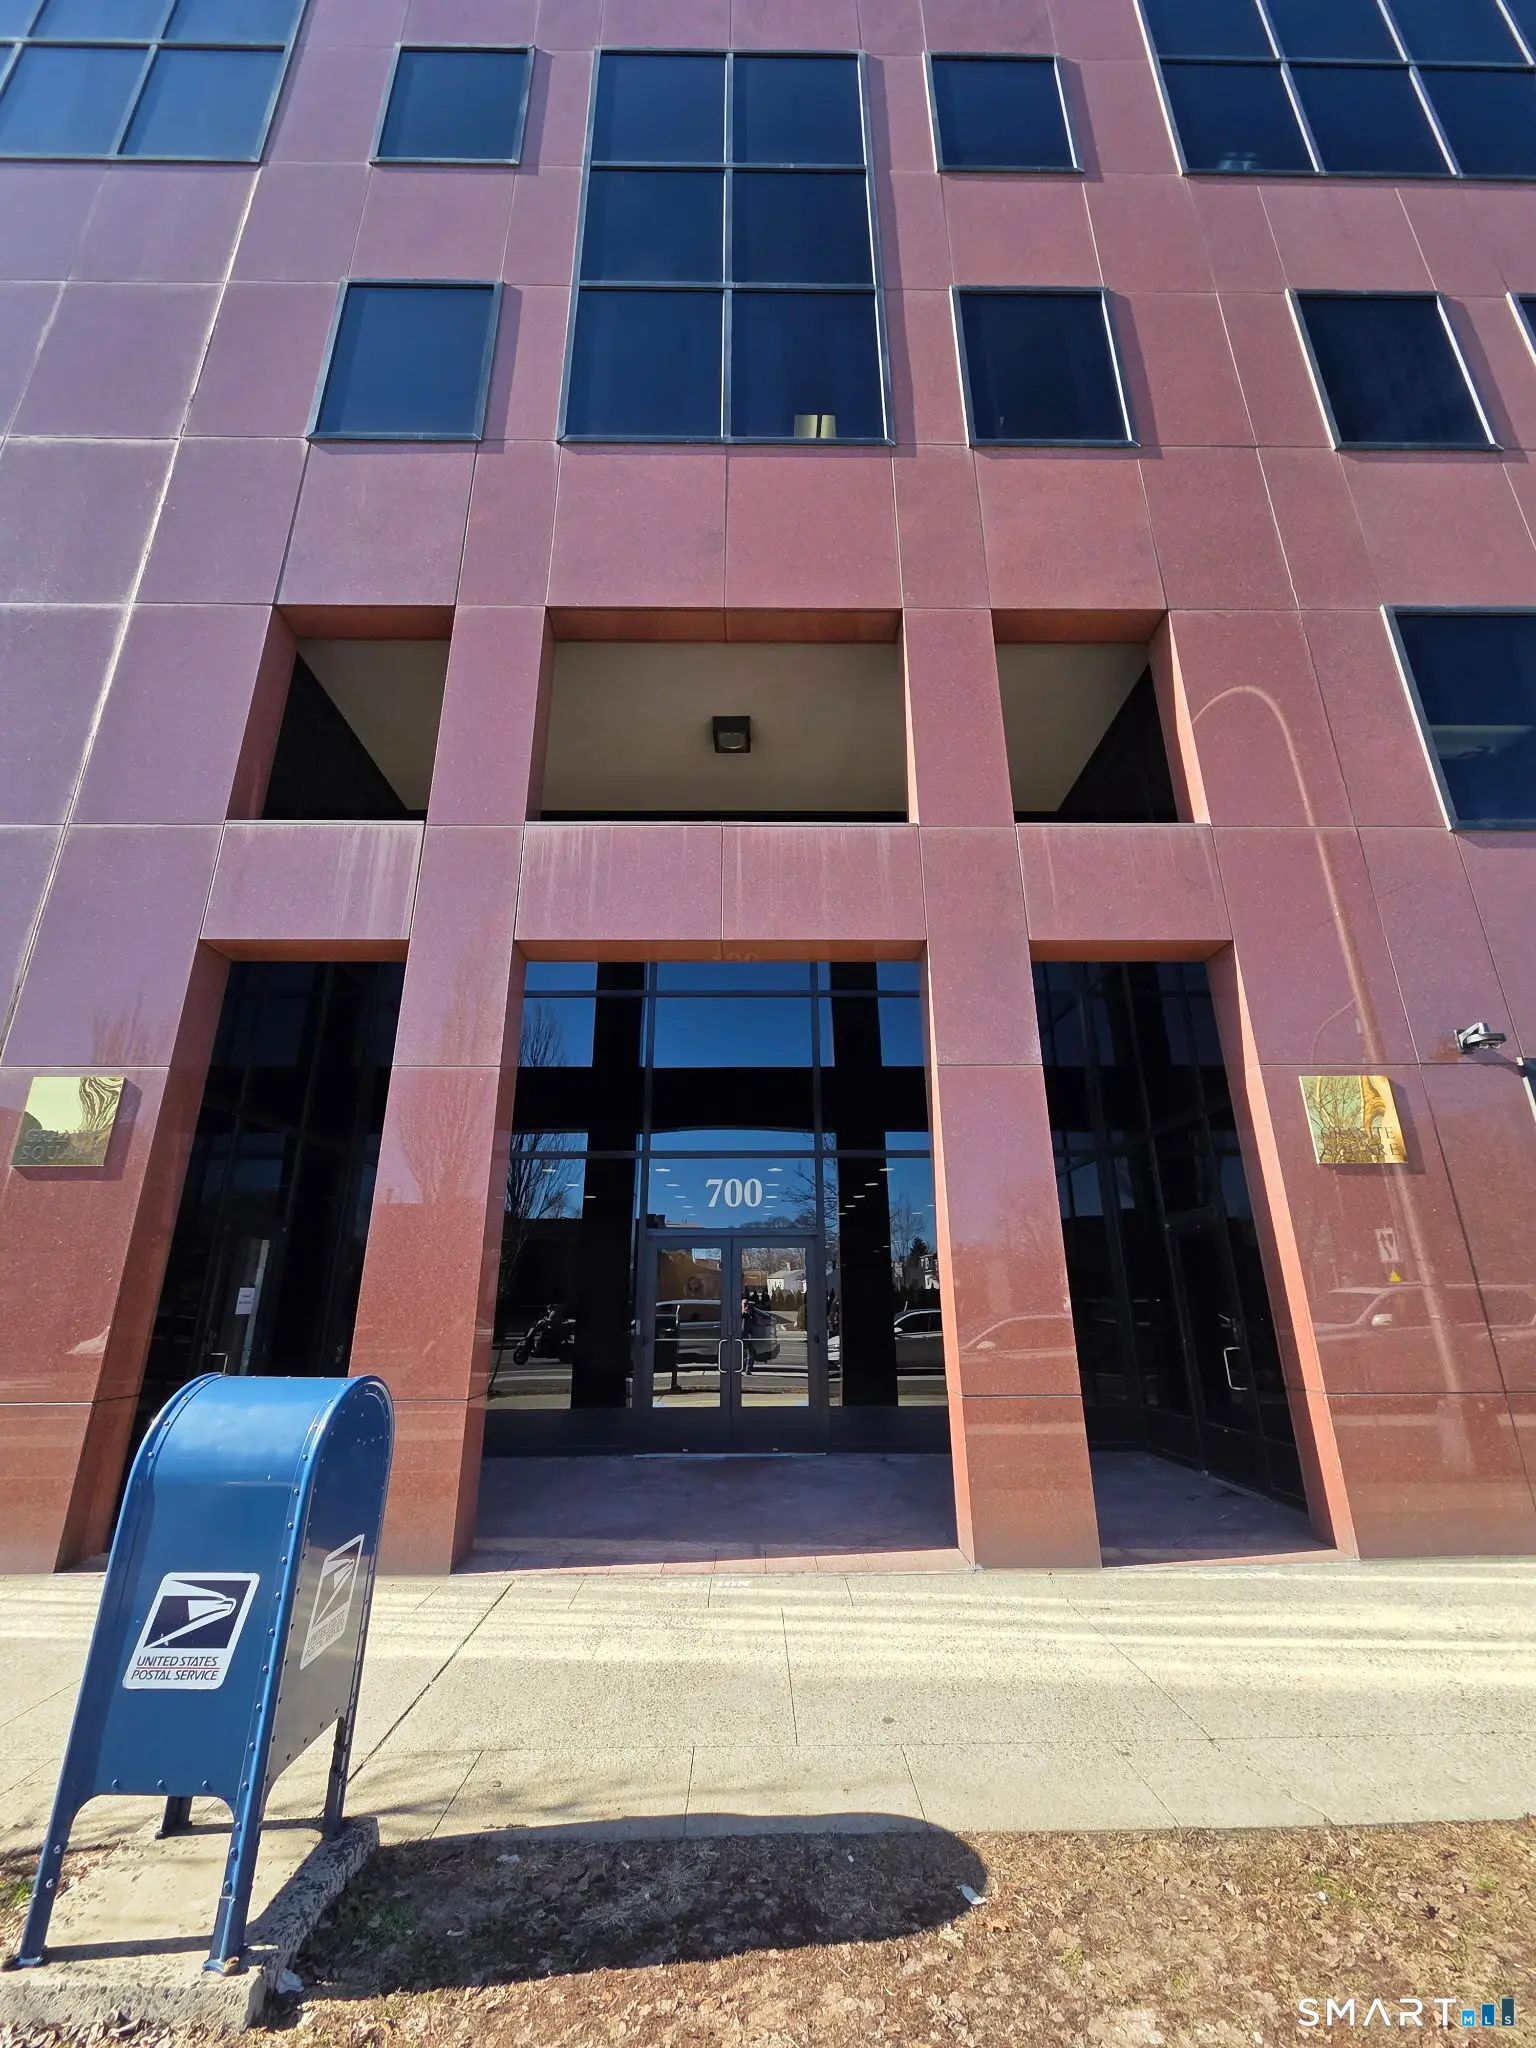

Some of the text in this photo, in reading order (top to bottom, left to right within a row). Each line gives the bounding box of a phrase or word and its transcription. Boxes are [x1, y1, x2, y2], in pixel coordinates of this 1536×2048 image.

[704, 1178, 763, 1208] 700
[136, 1656, 219, 1667] UNITED STATES
[131, 1670, 219, 1680] POSTAL SERVICE
